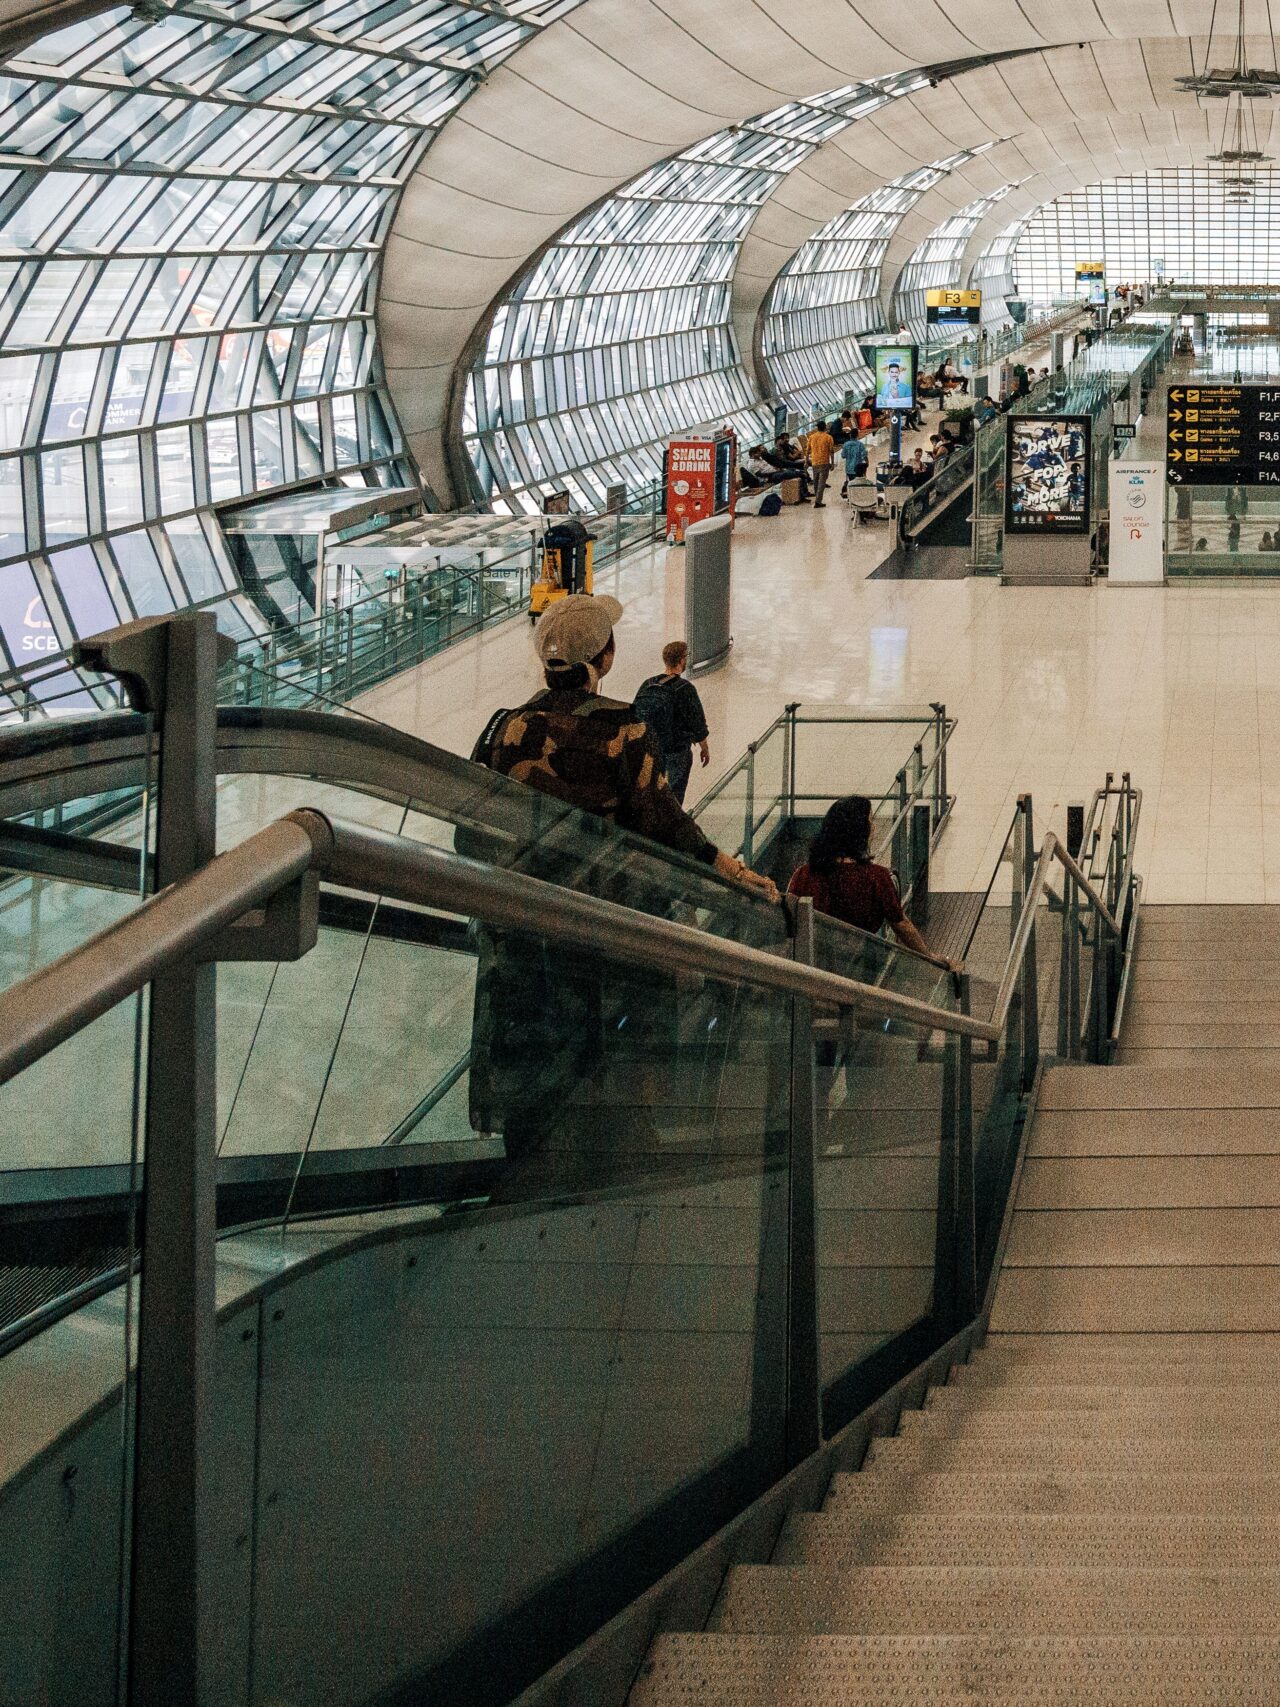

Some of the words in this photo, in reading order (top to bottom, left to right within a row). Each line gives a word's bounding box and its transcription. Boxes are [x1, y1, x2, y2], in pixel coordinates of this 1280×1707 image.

[945, 293, 961, 304] F3
[1259, 431, 1280, 442] F3,5
[1027, 433, 1071, 456] DRIVE
[672, 448, 711, 461] SNACK
[1259, 451, 1280, 462] F4,6
[1027, 485, 1069, 505] MORE
[22, 635, 61, 651] SCB
